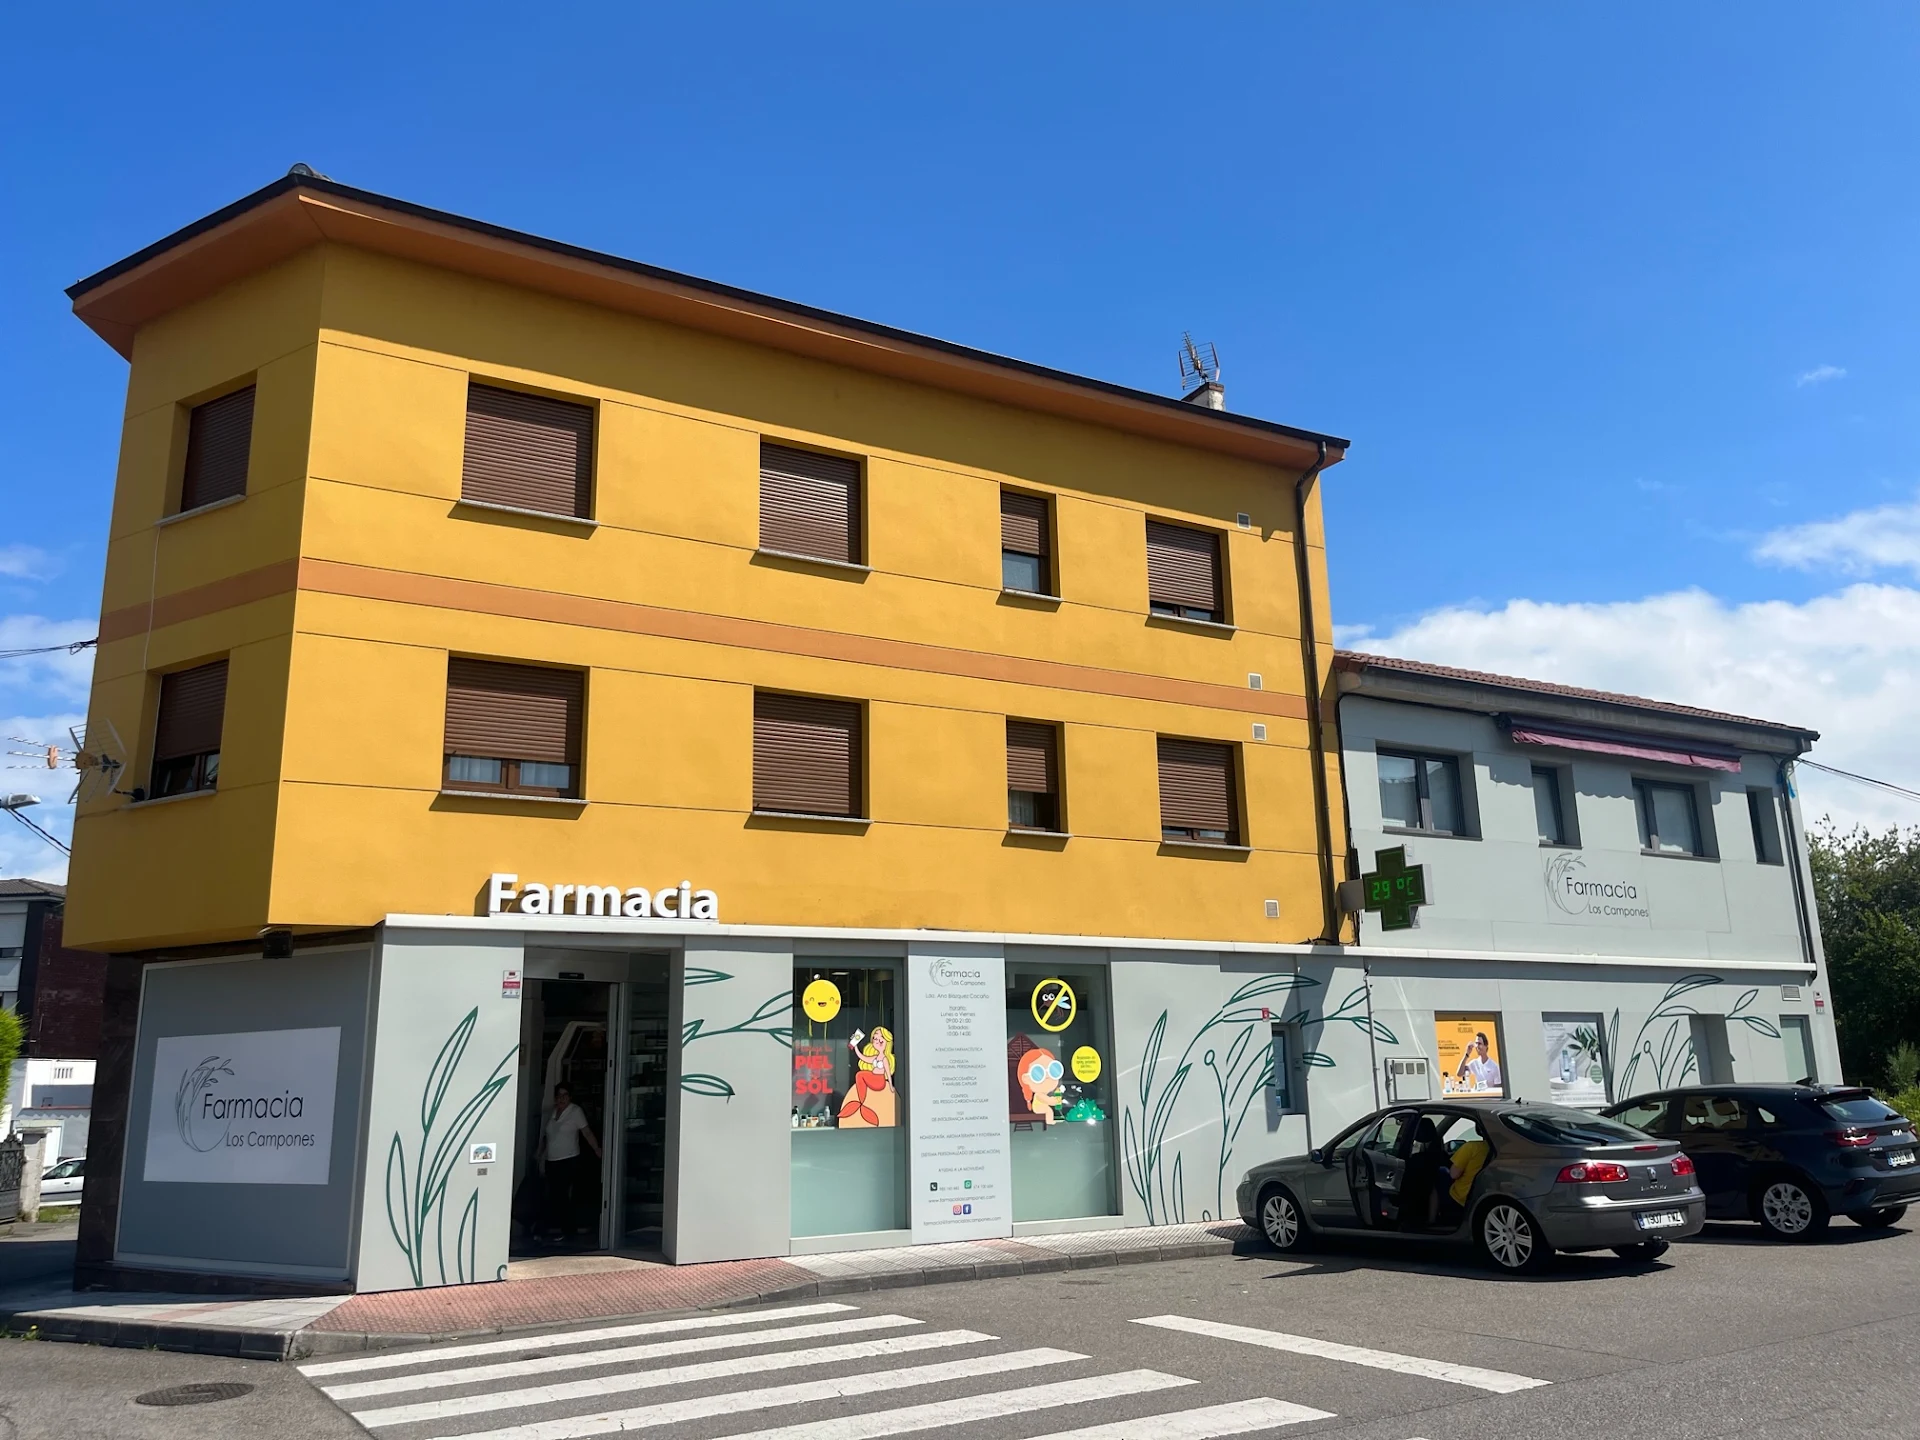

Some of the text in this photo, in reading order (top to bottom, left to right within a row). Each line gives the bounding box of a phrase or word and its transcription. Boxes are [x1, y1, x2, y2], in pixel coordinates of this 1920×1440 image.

[489, 873, 718, 919] Farmacia
[1373, 881, 1391, 900] 29
[1566, 877, 1637, 899] Farmacia
[1588, 904, 1649, 918] Los Campones
[941, 969, 981, 978] Farmacia
[795, 1055, 833, 1070] PIEL
[795, 1078, 833, 1095] SOL
[203, 1090, 304, 1119] Farmacia
[226, 1131, 315, 1150] Los Campones
